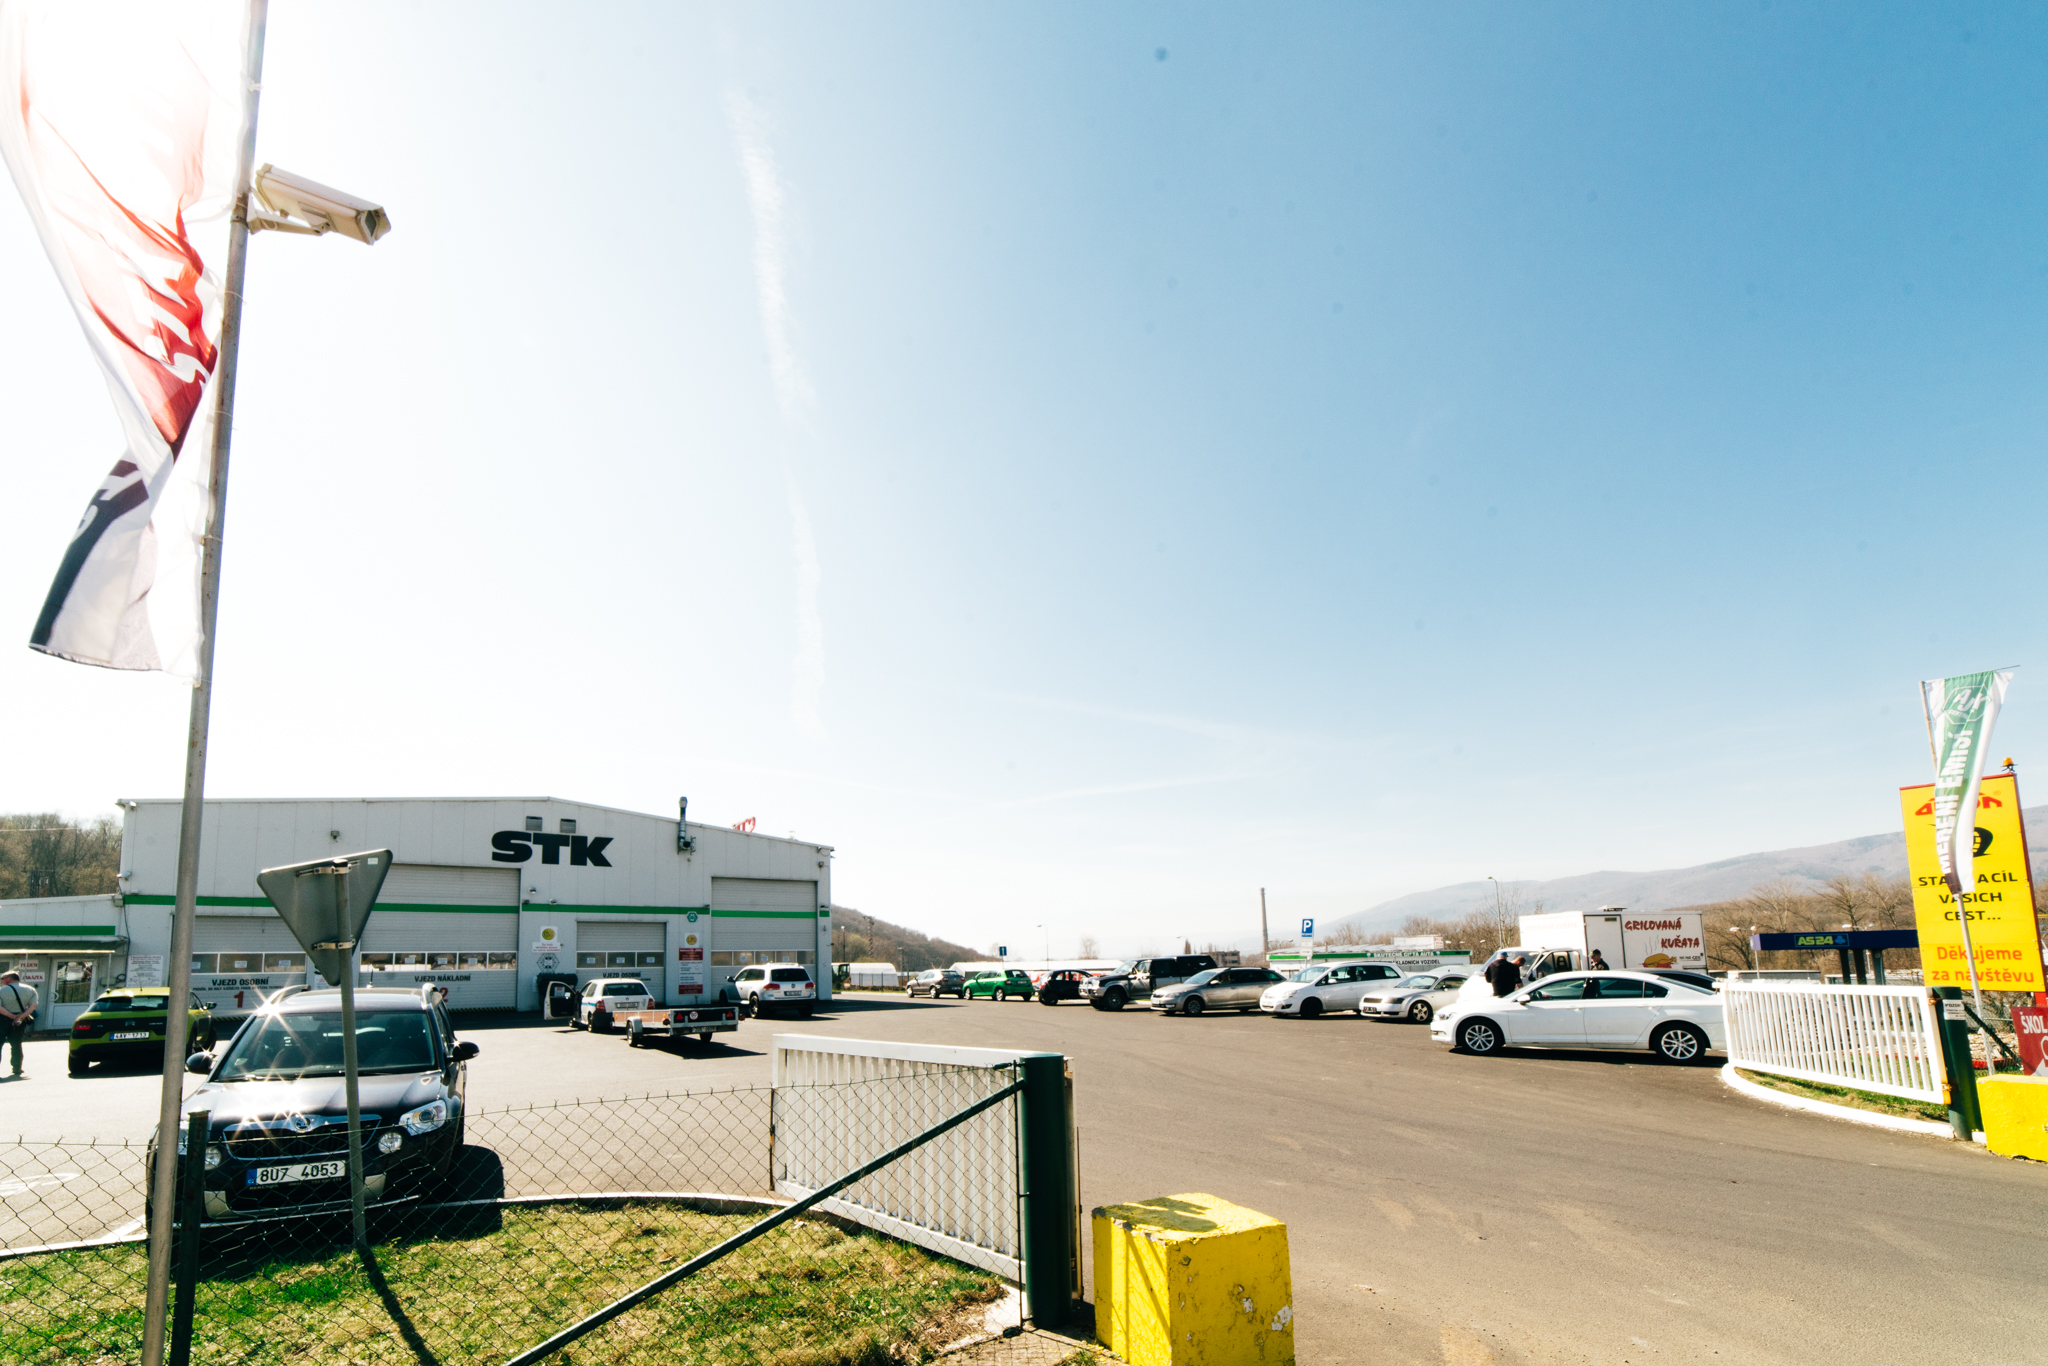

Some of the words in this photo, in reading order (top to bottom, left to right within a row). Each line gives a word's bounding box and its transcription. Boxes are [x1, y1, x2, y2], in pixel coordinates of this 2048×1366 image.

[1937, 730, 1973, 788] EMISÍ
[491, 830, 614, 867] STK
[1977, 873, 1989, 884] A
[1991, 869, 2018, 883] CÍL
[1303, 919, 1312, 932] P
[1625, 917, 1682, 931] GRILOVANÁ
[1661, 935, 1700, 949] KUŘATA
[1389, 958, 1420, 966] KLADNÍCH
[1937, 946, 2023, 964] Děkujeme
[211, 978, 237, 986] VJEZD
[239, 976, 269, 986] OSOBNÍ
[437, 973, 472, 982] NÁKLADNÍ
[1932, 970, 1950, 981] za
[1955, 968, 2035, 983] návštěvu
[233, 990, 245, 1008] 1
[439, 987, 449, 1003] 2
[260, 1167, 290, 1183] 8U7
[301, 1162, 338, 1178] 4053
